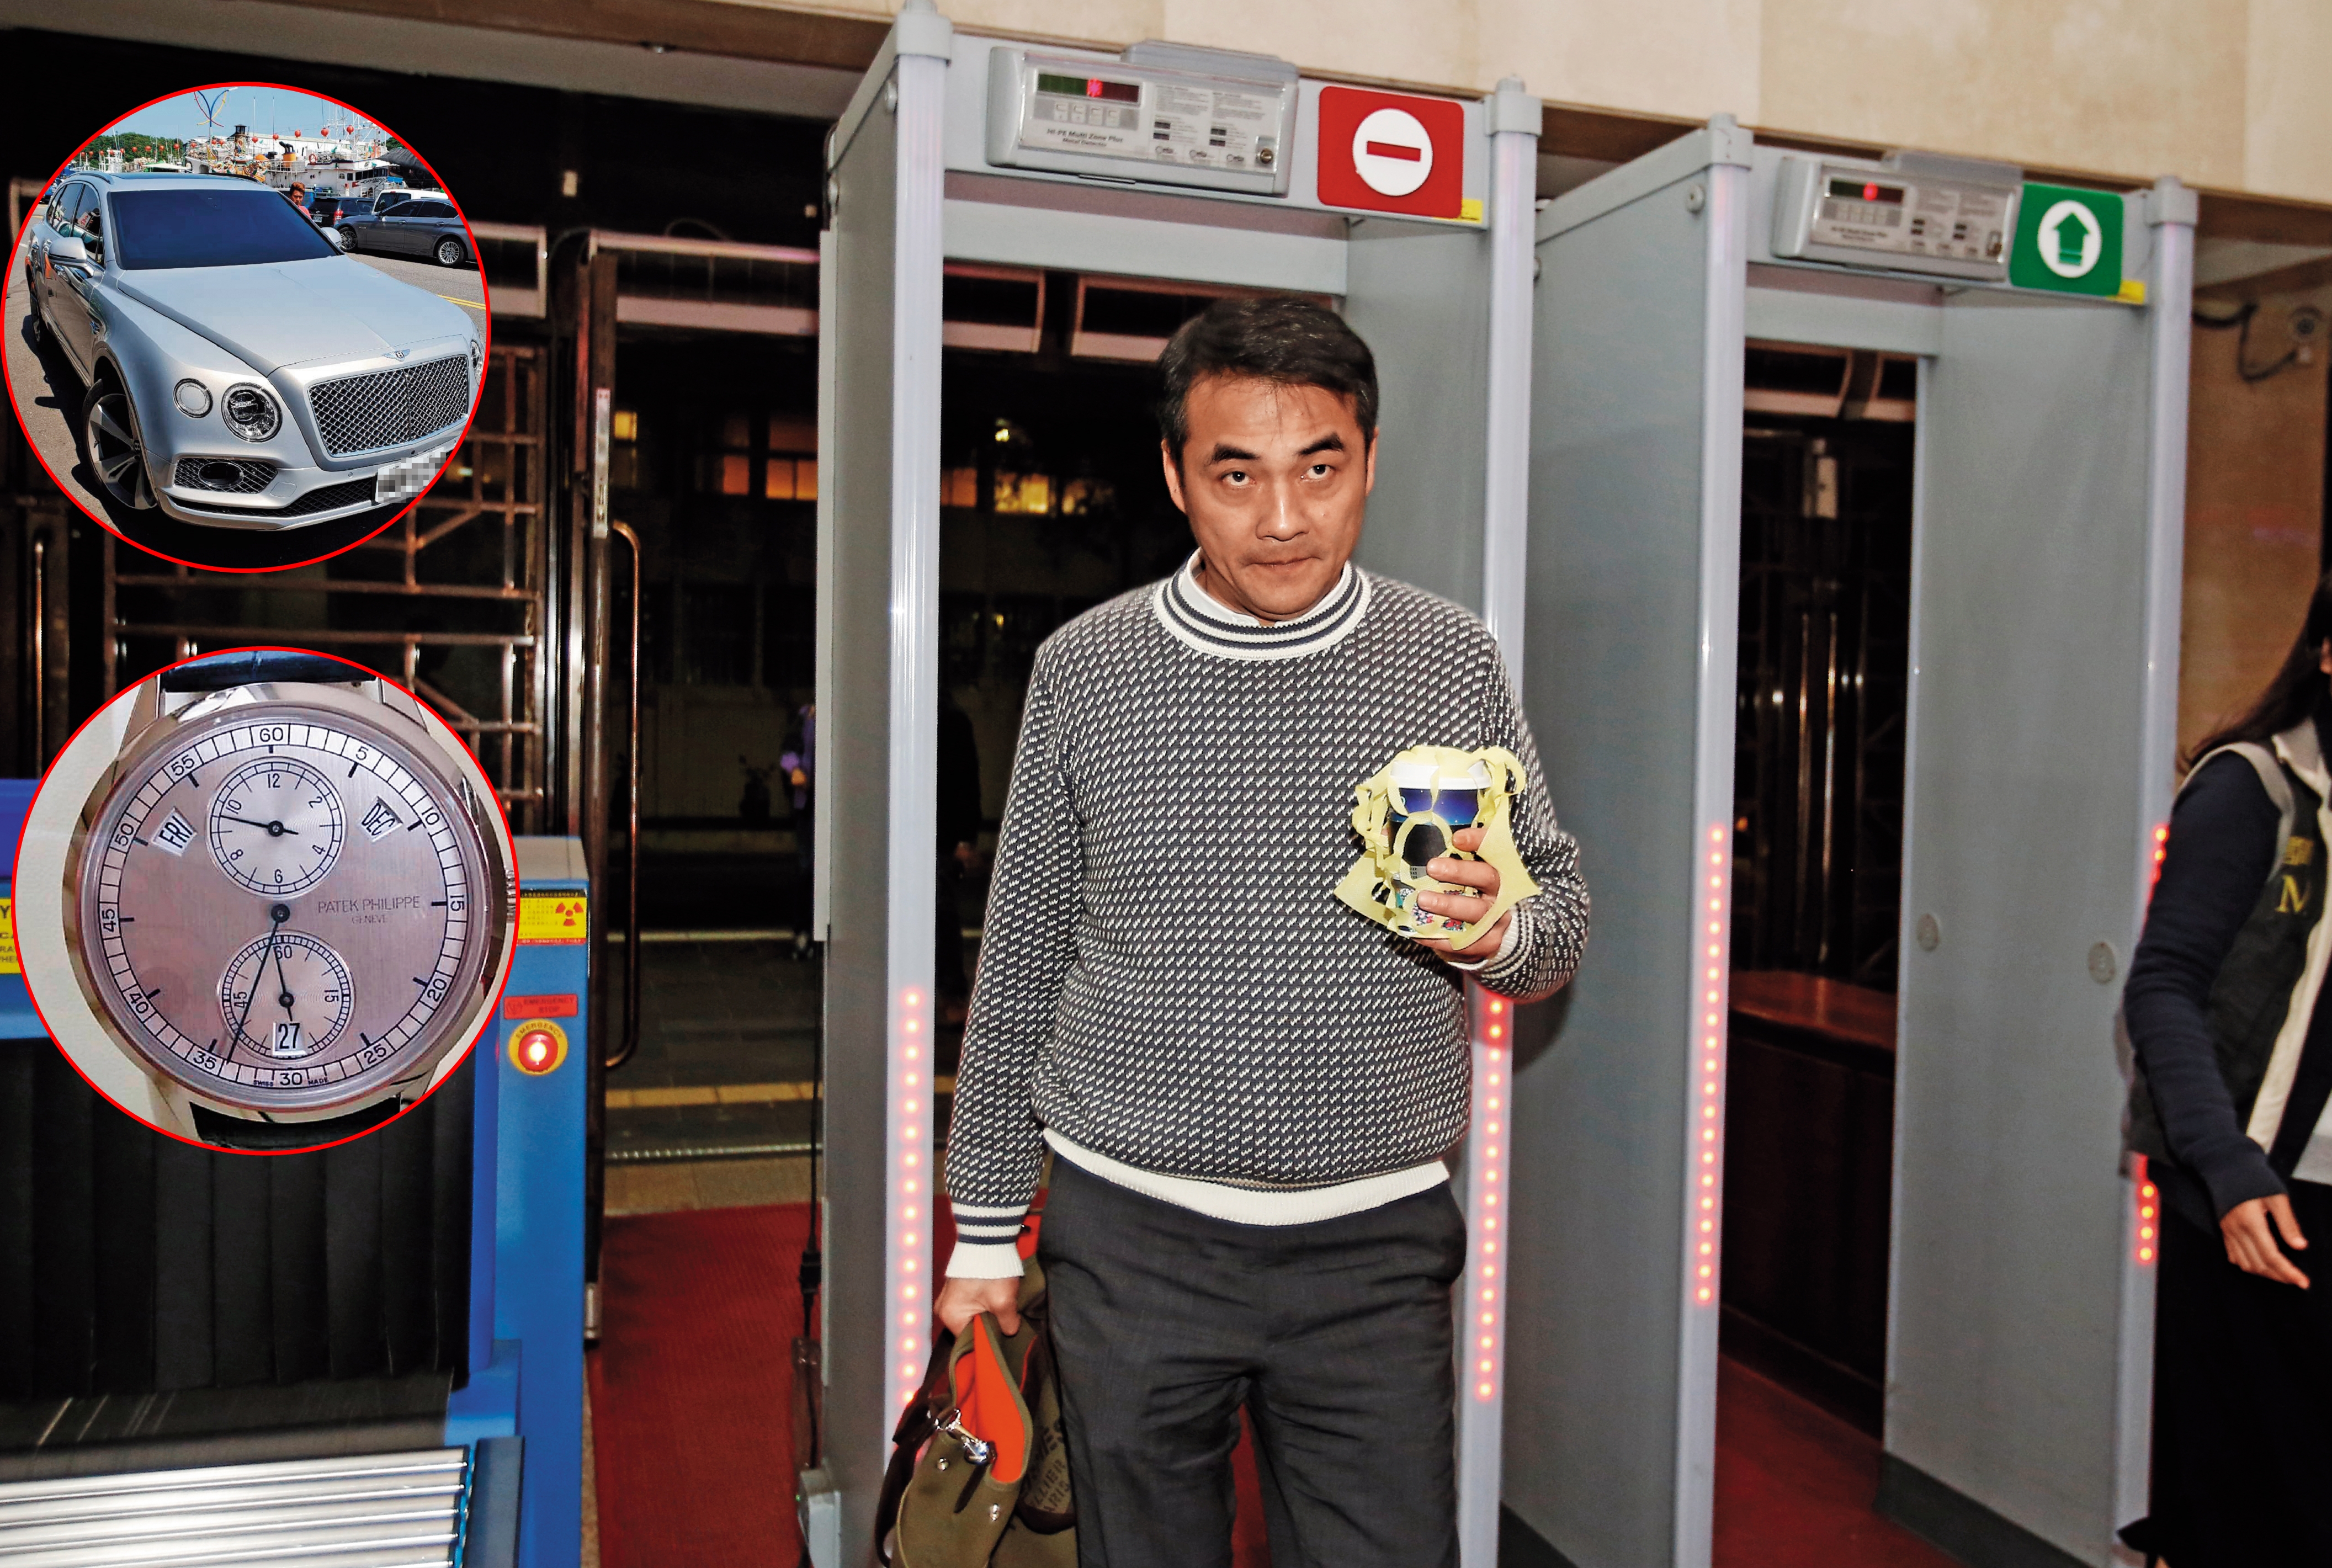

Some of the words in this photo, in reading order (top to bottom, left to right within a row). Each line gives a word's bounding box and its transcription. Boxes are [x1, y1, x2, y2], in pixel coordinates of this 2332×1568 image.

[260, 727, 284, 742] 60
[355, 746, 369, 761] 5
[171, 754, 195, 776] 55
[267, 773, 281, 788] 12
[225, 799, 242, 815] 10
[308, 796, 323, 809] 2
[361, 802, 396, 836] DEC
[421, 806, 440, 825] 10
[114, 822, 134, 846] 50
[159, 815, 193, 849] FRI
[230, 849, 243, 860] 8
[312, 844, 326, 855] 4
[274, 869, 283, 884] 6
[318, 900, 359, 913] PATEK
[363, 896, 420, 911] PHILIPPE
[450, 895, 465, 911] 15
[102, 908, 116, 933] 45
[274, 945, 293, 960] 60
[324, 989, 338, 1003] 15
[427, 979, 447, 1002] 20
[129, 992, 148, 1014] 40
[233, 991, 248, 1009] 45
[278, 1023, 300, 1049] 27
[193, 1051, 217, 1070] 35
[364, 1044, 386, 1064] 25
[280, 1072, 302, 1086] 30
